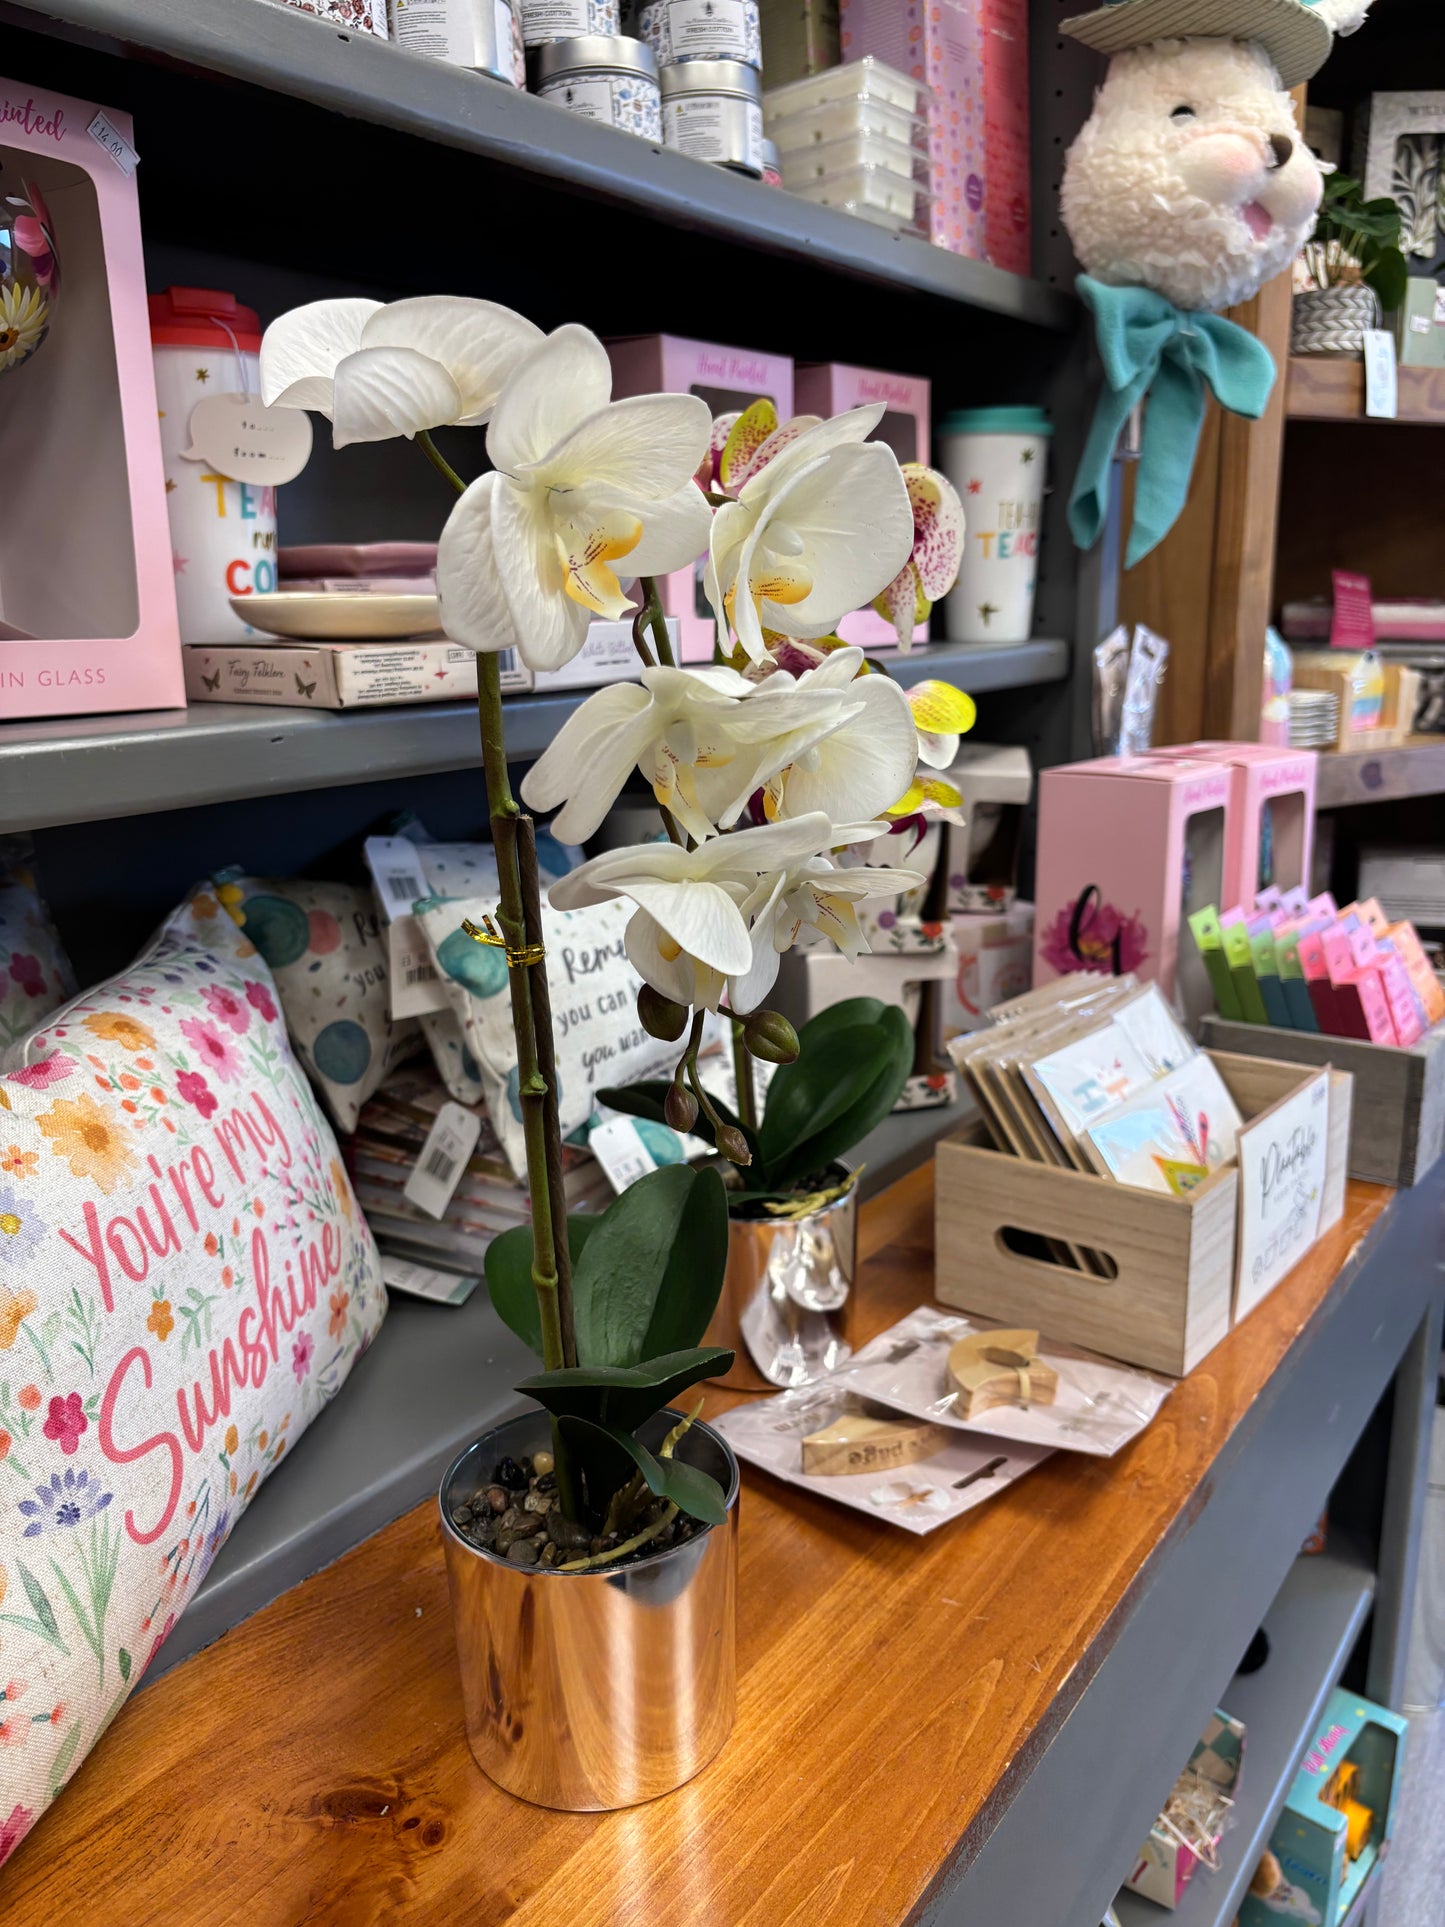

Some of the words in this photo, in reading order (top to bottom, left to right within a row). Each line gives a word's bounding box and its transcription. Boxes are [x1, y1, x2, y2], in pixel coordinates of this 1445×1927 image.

[0, 99, 67, 142] inted
[38, 668, 106, 688] GLASS
[353, 964, 387, 996] you
[557, 1004, 592, 1037] you
[597, 990, 628, 1015] can
[582, 1044, 616, 1082] you
[58, 1145, 225, 1313] You're
[213, 1090, 291, 1185] my
[99, 1222, 342, 1546] Sunshine
